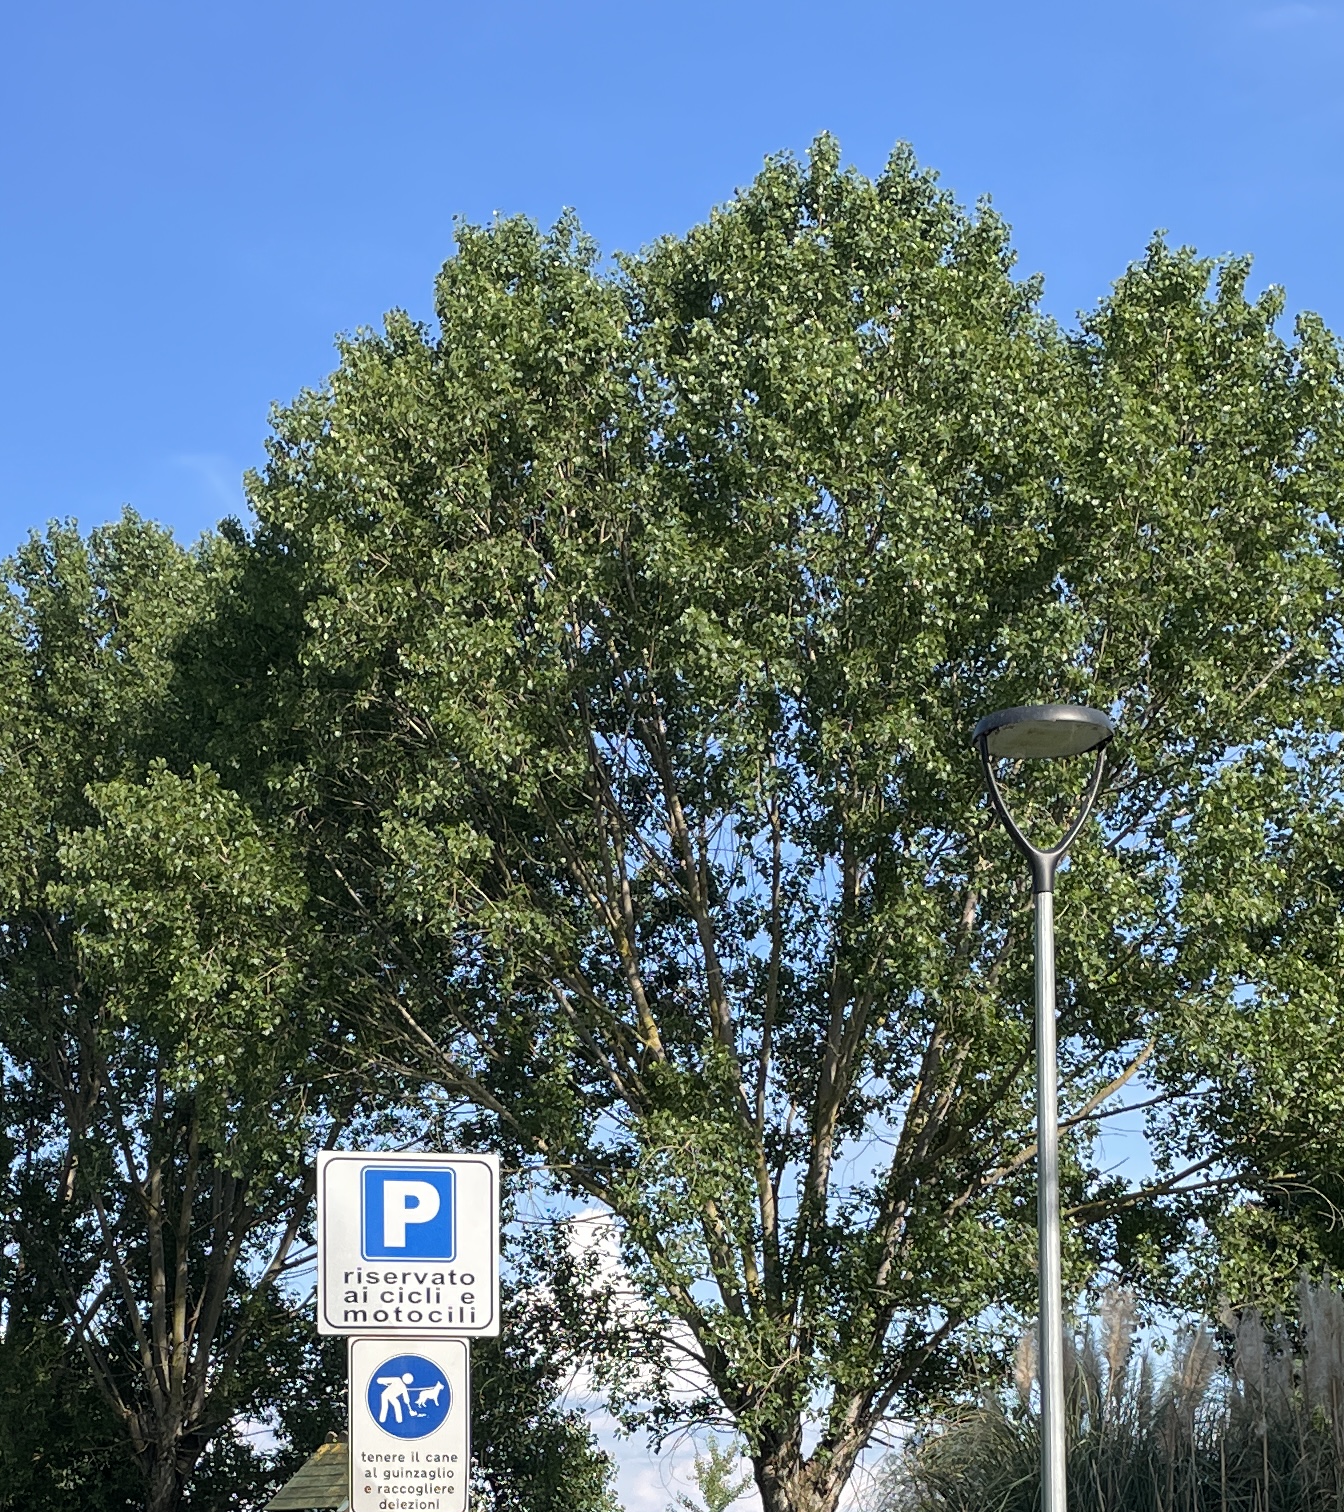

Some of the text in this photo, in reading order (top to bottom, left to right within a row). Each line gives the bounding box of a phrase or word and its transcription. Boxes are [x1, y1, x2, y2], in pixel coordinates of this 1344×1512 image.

[384, 1180, 440, 1247] P
[344, 1267, 475, 1285] riservato
[344, 1286, 475, 1304] ai cicli e
[344, 1306, 475, 1323] motocili
[361, 1451, 458, 1463] tenere il cane
[365, 1467, 454, 1480] al guinzaglio
[364, 1483, 454, 1496] e raccogliere
